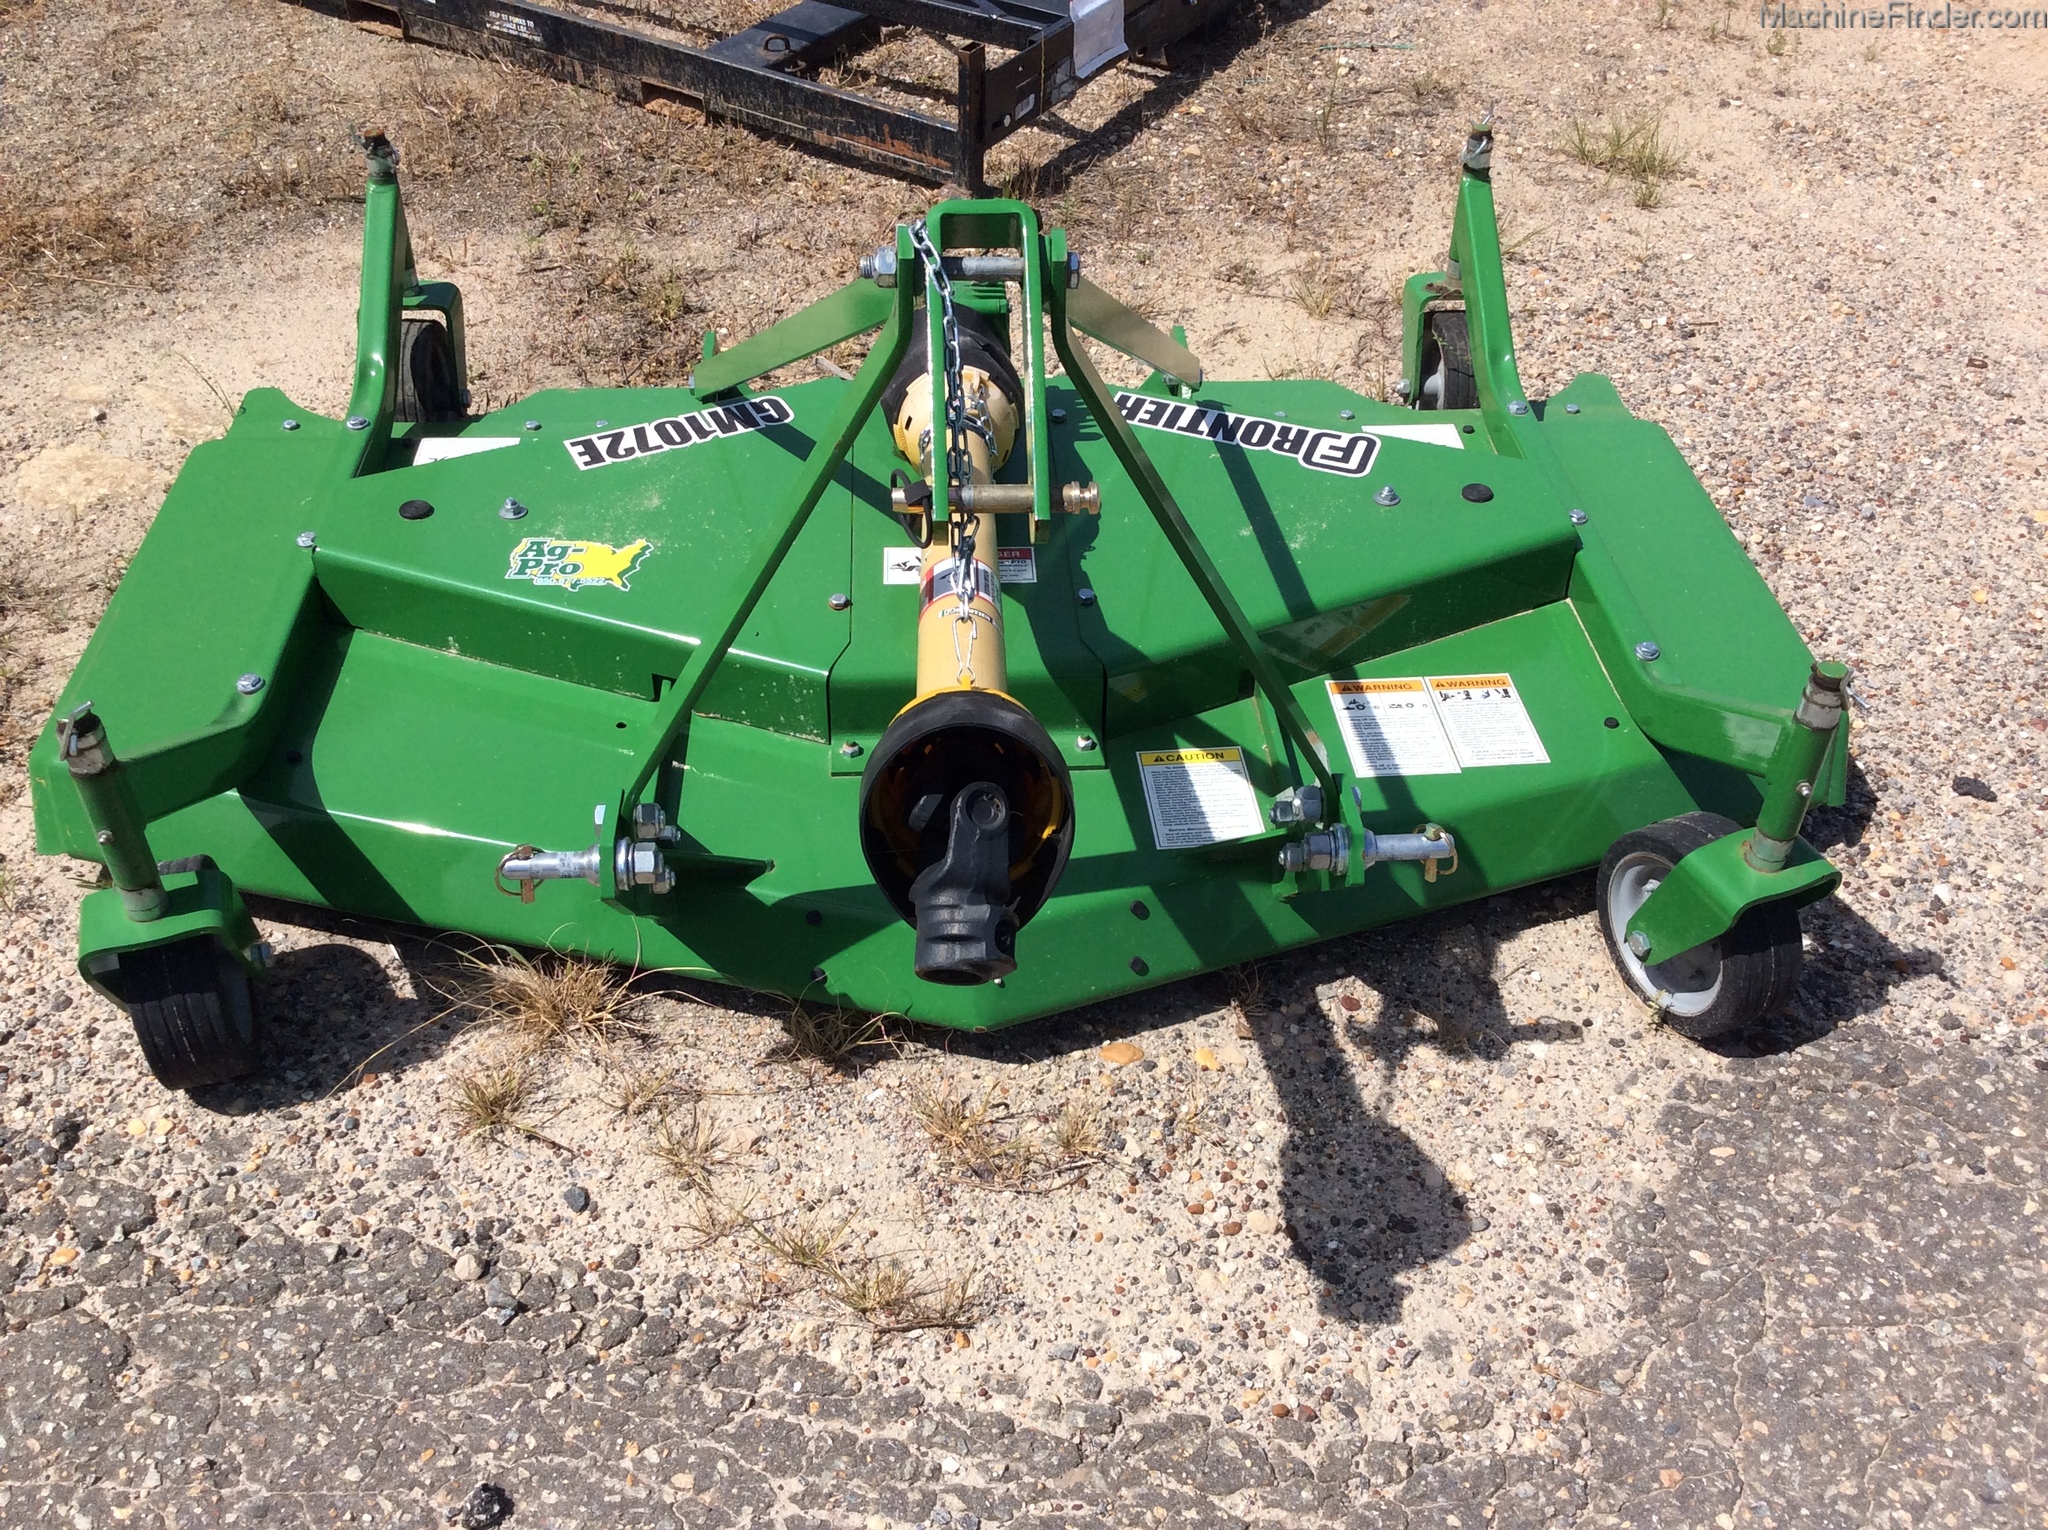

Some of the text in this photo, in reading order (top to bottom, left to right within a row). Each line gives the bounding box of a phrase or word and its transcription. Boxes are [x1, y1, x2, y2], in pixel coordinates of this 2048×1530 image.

[570, 398, 790, 467] GM1072E
[1115, 394, 1378, 475] FRONTIER
[517, 540, 586, 561] Ag-
[512, 558, 582, 576] Pro
[1352, 681, 1413, 692] WARNING
[1446, 679, 1508, 688] WARNING
[1166, 752, 1224, 762] CAUTION
